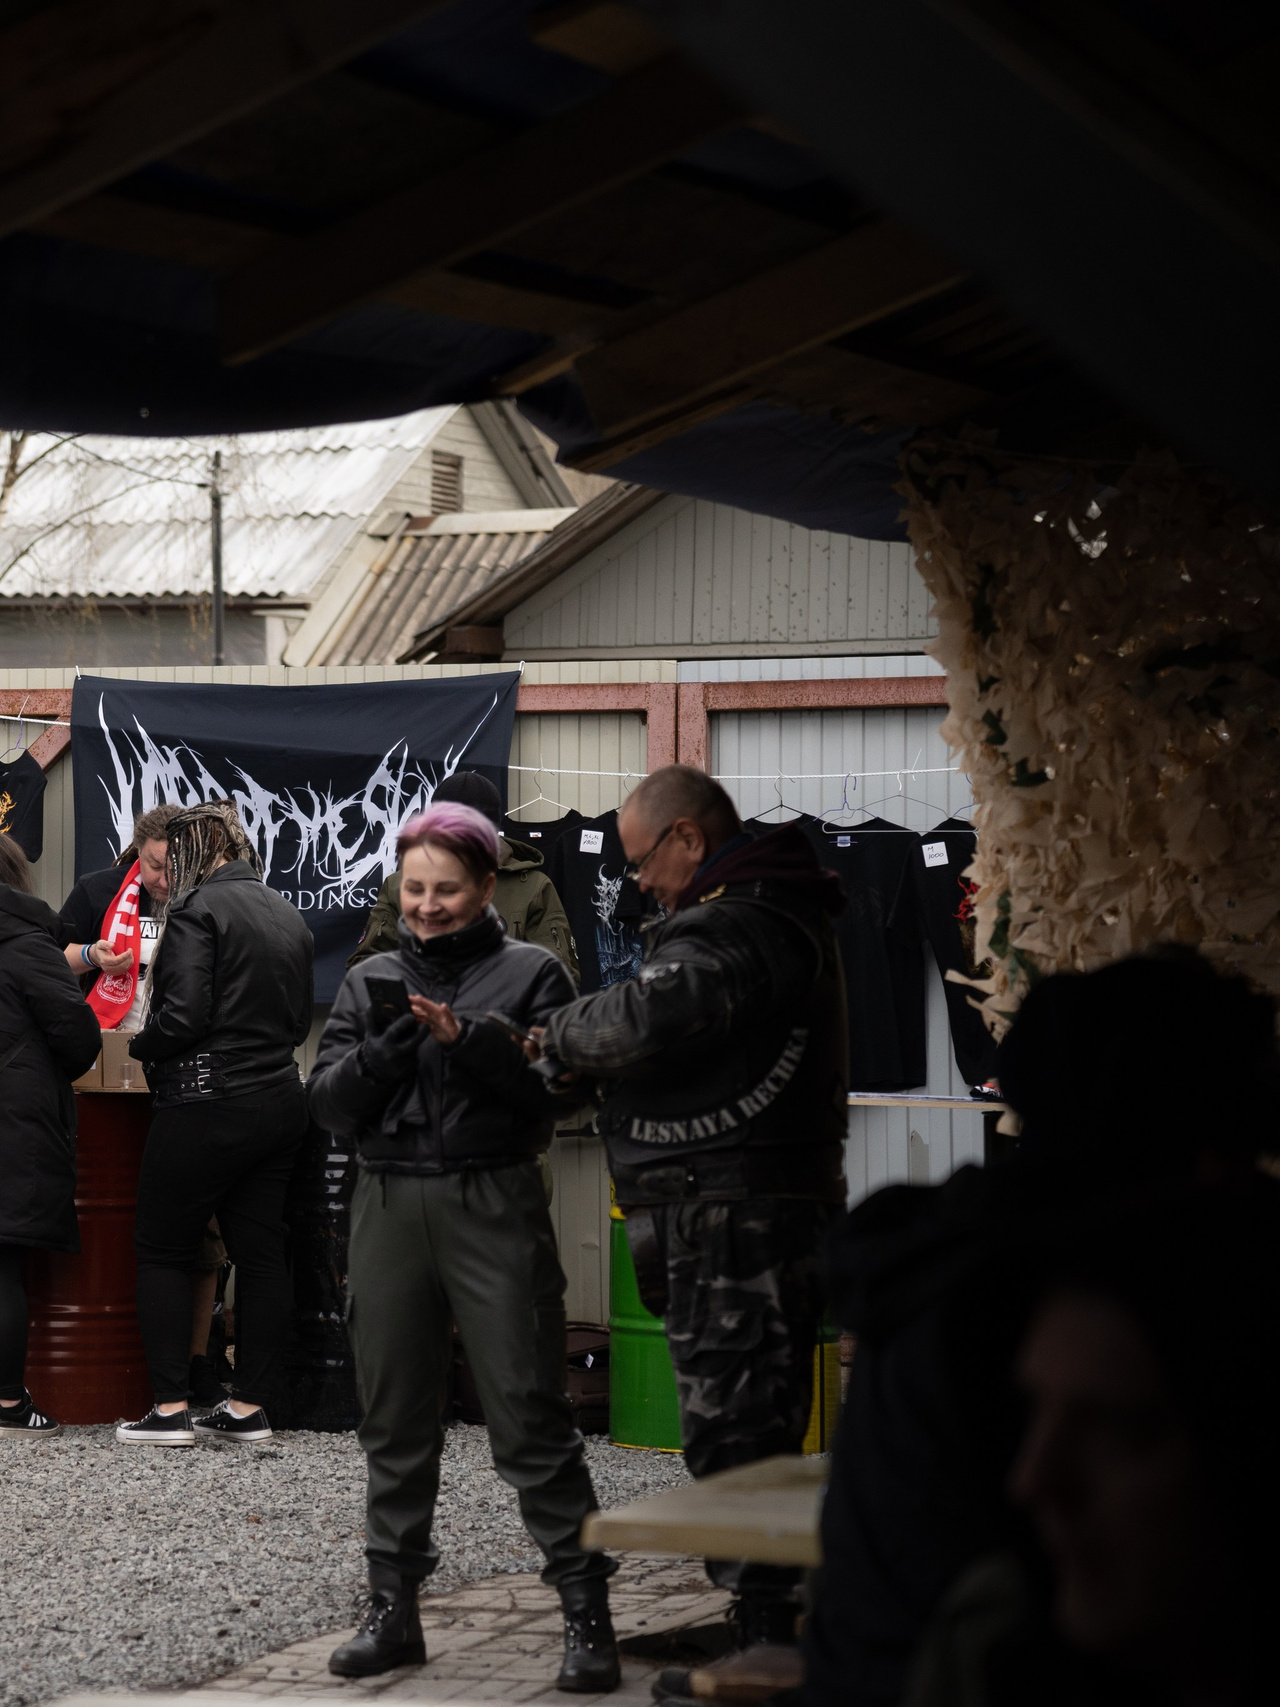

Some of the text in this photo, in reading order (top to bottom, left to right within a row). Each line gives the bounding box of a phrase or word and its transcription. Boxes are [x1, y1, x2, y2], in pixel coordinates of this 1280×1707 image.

[281, 886, 379, 911] RDINGS
[629, 1026, 809, 1145] LESNAYA RECHKA
